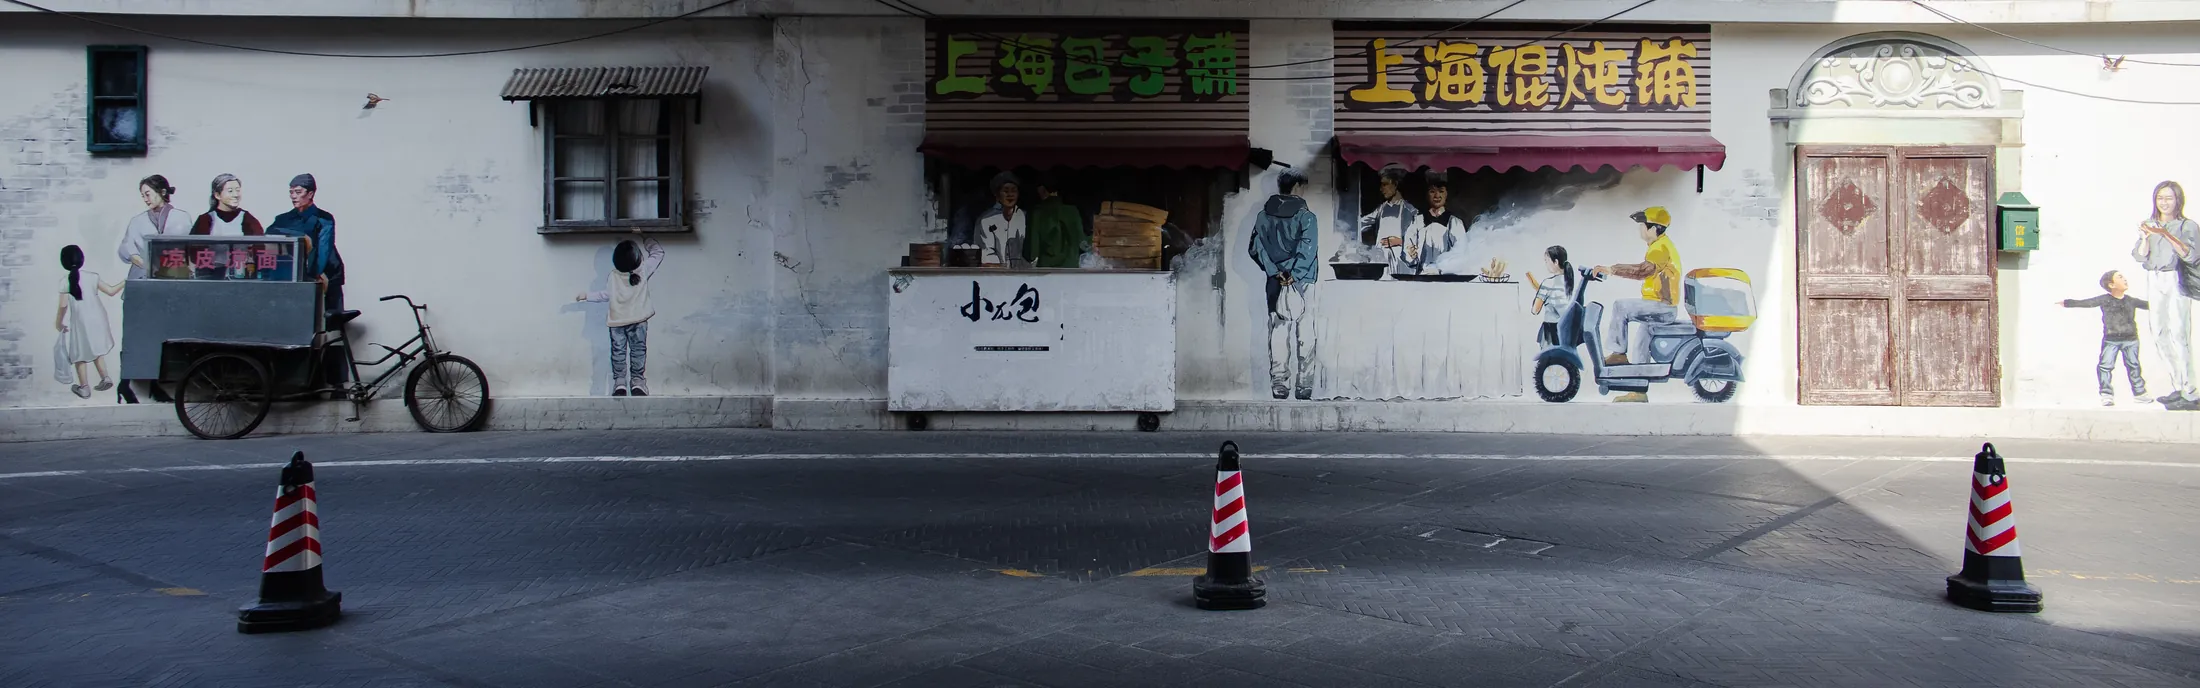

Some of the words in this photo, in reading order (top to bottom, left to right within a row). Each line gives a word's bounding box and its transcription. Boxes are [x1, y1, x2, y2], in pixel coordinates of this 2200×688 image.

[936, 31, 1237, 94] 上海包子铺
[161, 248, 277, 270] 凉皮凉面
